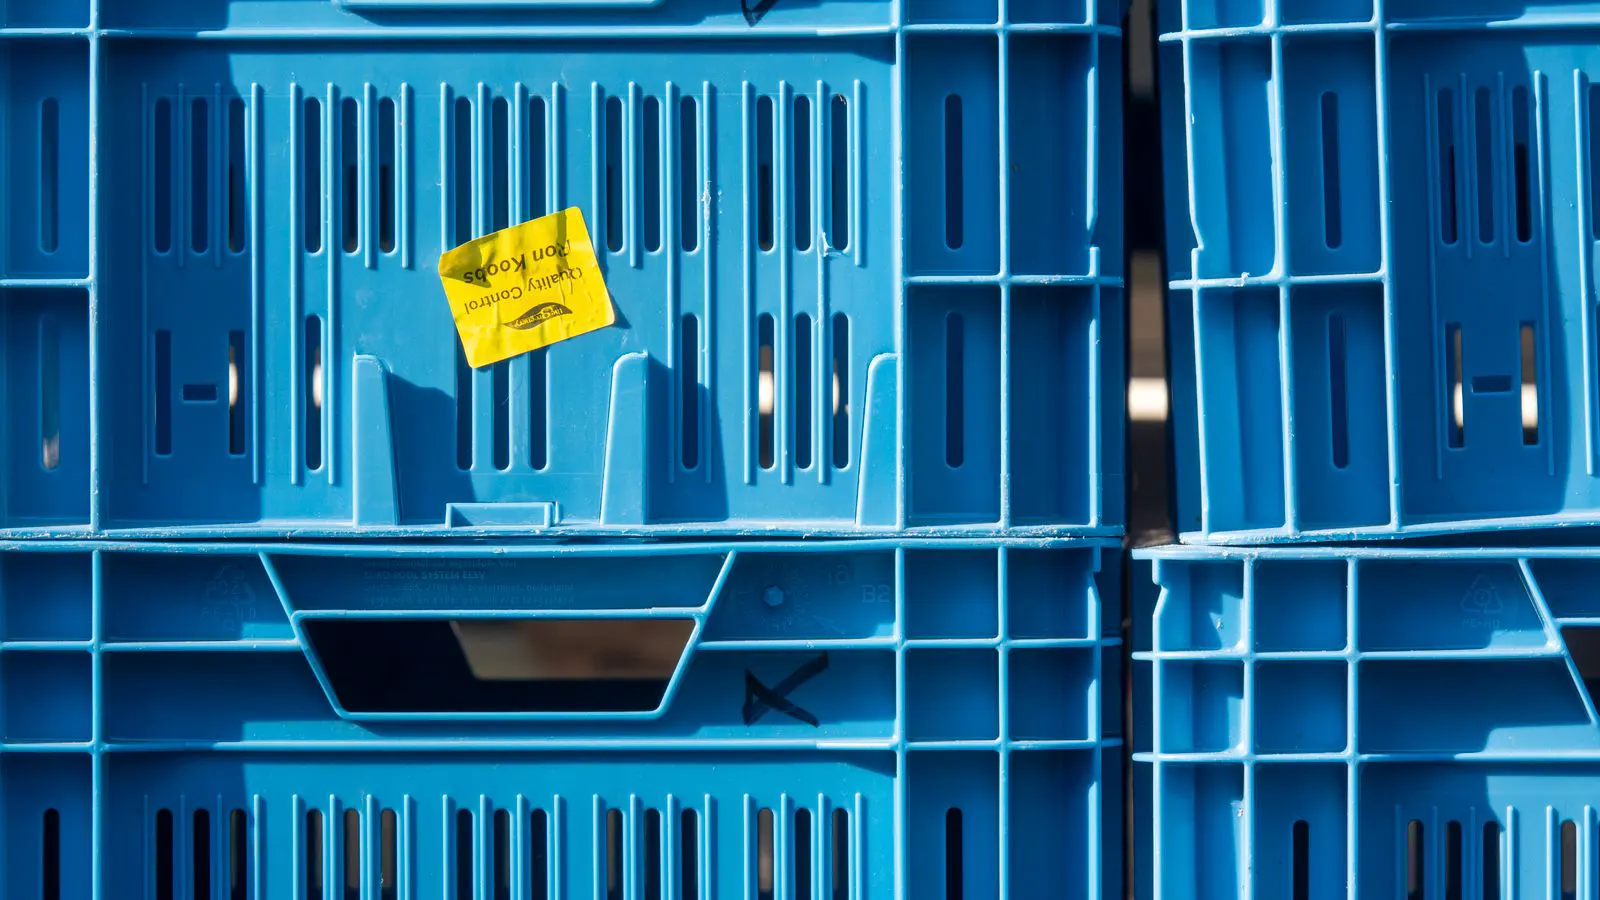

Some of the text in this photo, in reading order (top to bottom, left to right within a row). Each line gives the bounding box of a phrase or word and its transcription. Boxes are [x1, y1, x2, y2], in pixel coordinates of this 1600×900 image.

[463, 239, 571, 283] Ron Koobs
[464, 267, 583, 314] Quality Control
[860, 584, 891, 603] B2
